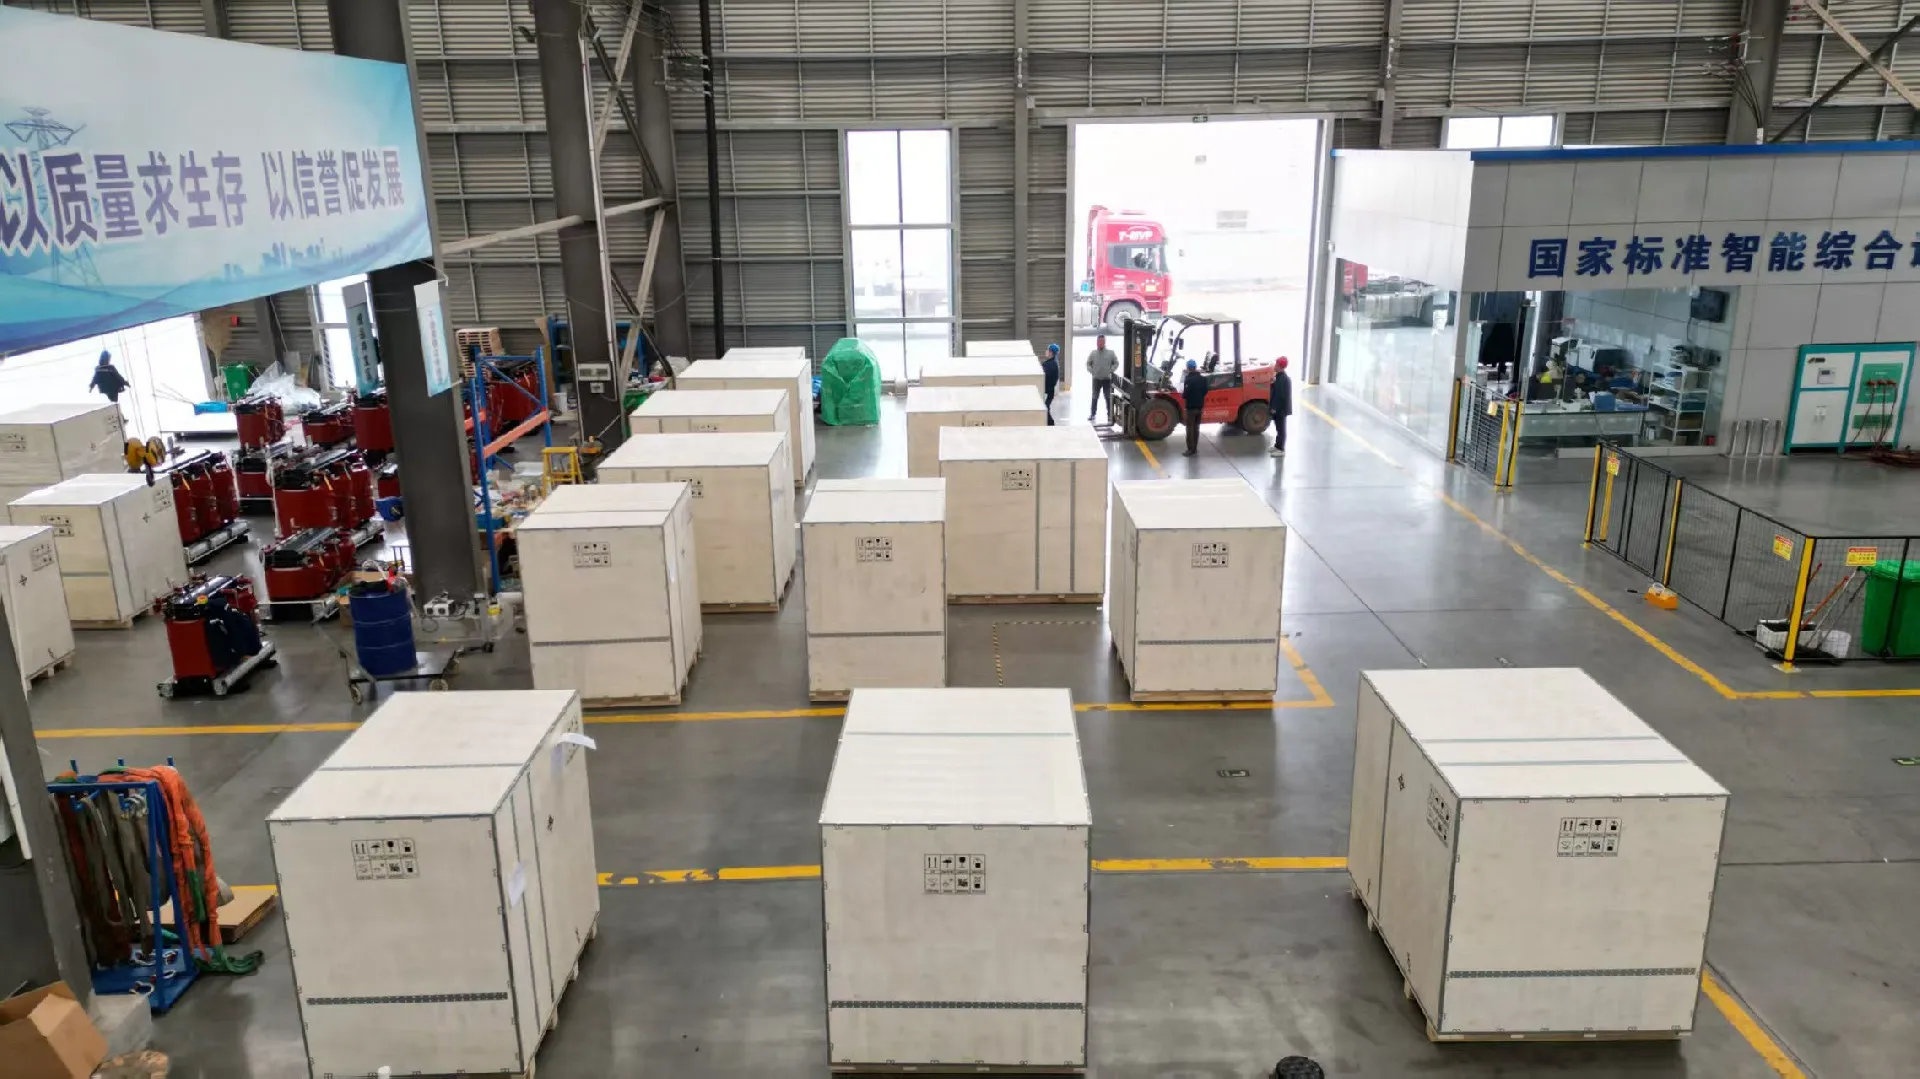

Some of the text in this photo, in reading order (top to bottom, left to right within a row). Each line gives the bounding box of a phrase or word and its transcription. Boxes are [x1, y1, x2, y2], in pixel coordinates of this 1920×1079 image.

[0, 150, 247, 250] 以质量求生存
[261, 149, 404, 221] 以信誉促发展
